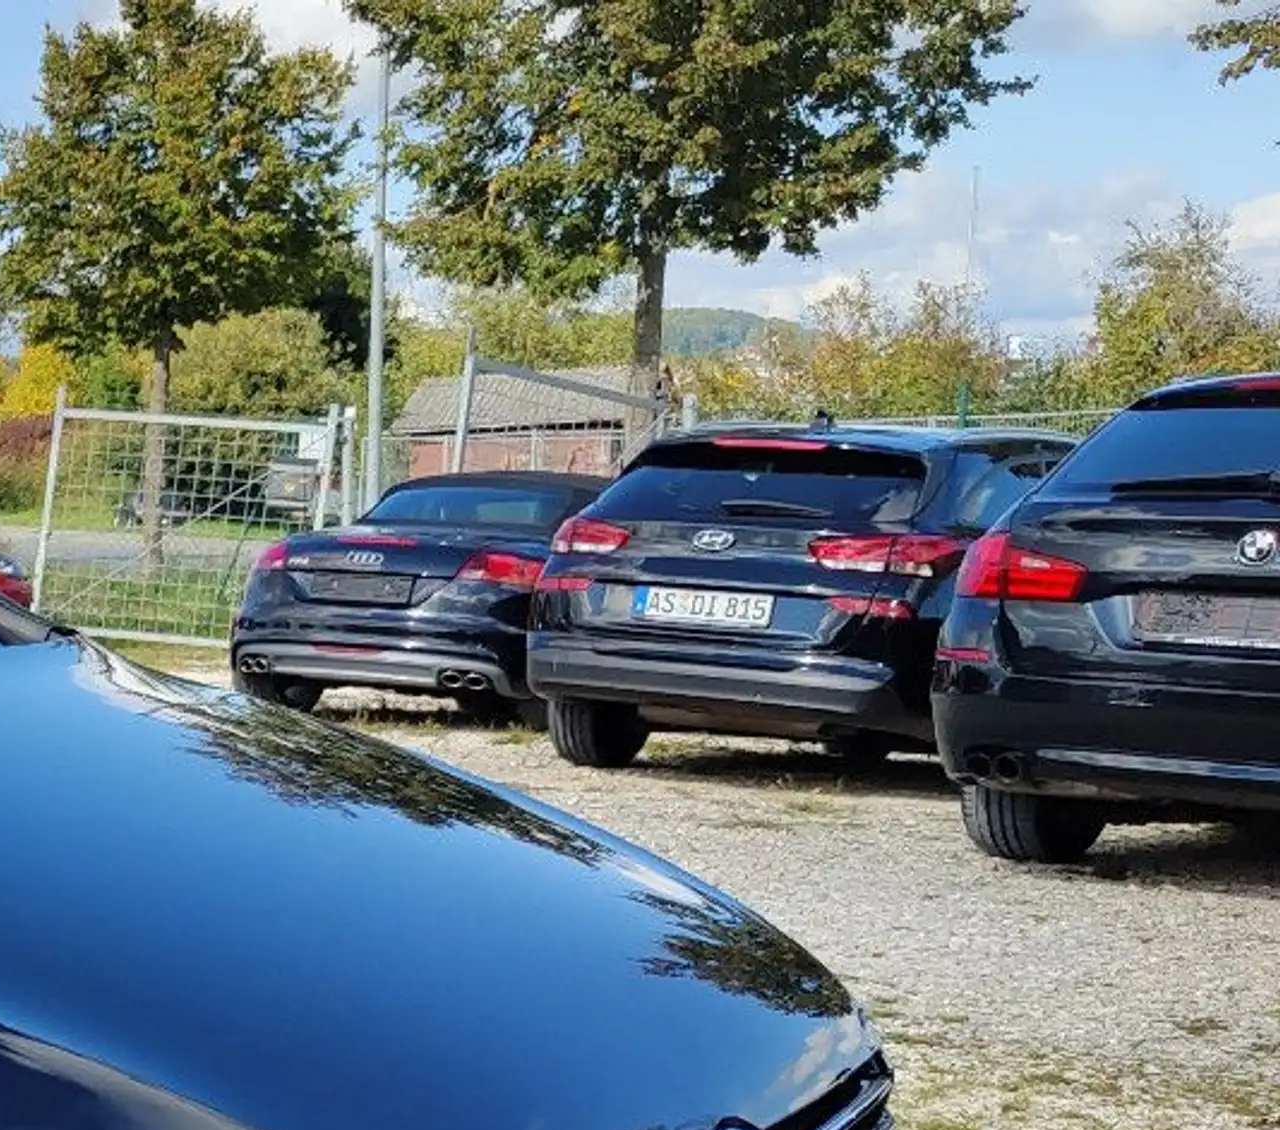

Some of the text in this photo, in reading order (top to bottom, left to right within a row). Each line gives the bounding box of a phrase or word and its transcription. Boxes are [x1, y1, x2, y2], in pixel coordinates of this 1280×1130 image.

[647, 592, 768, 620] AS DI 815
